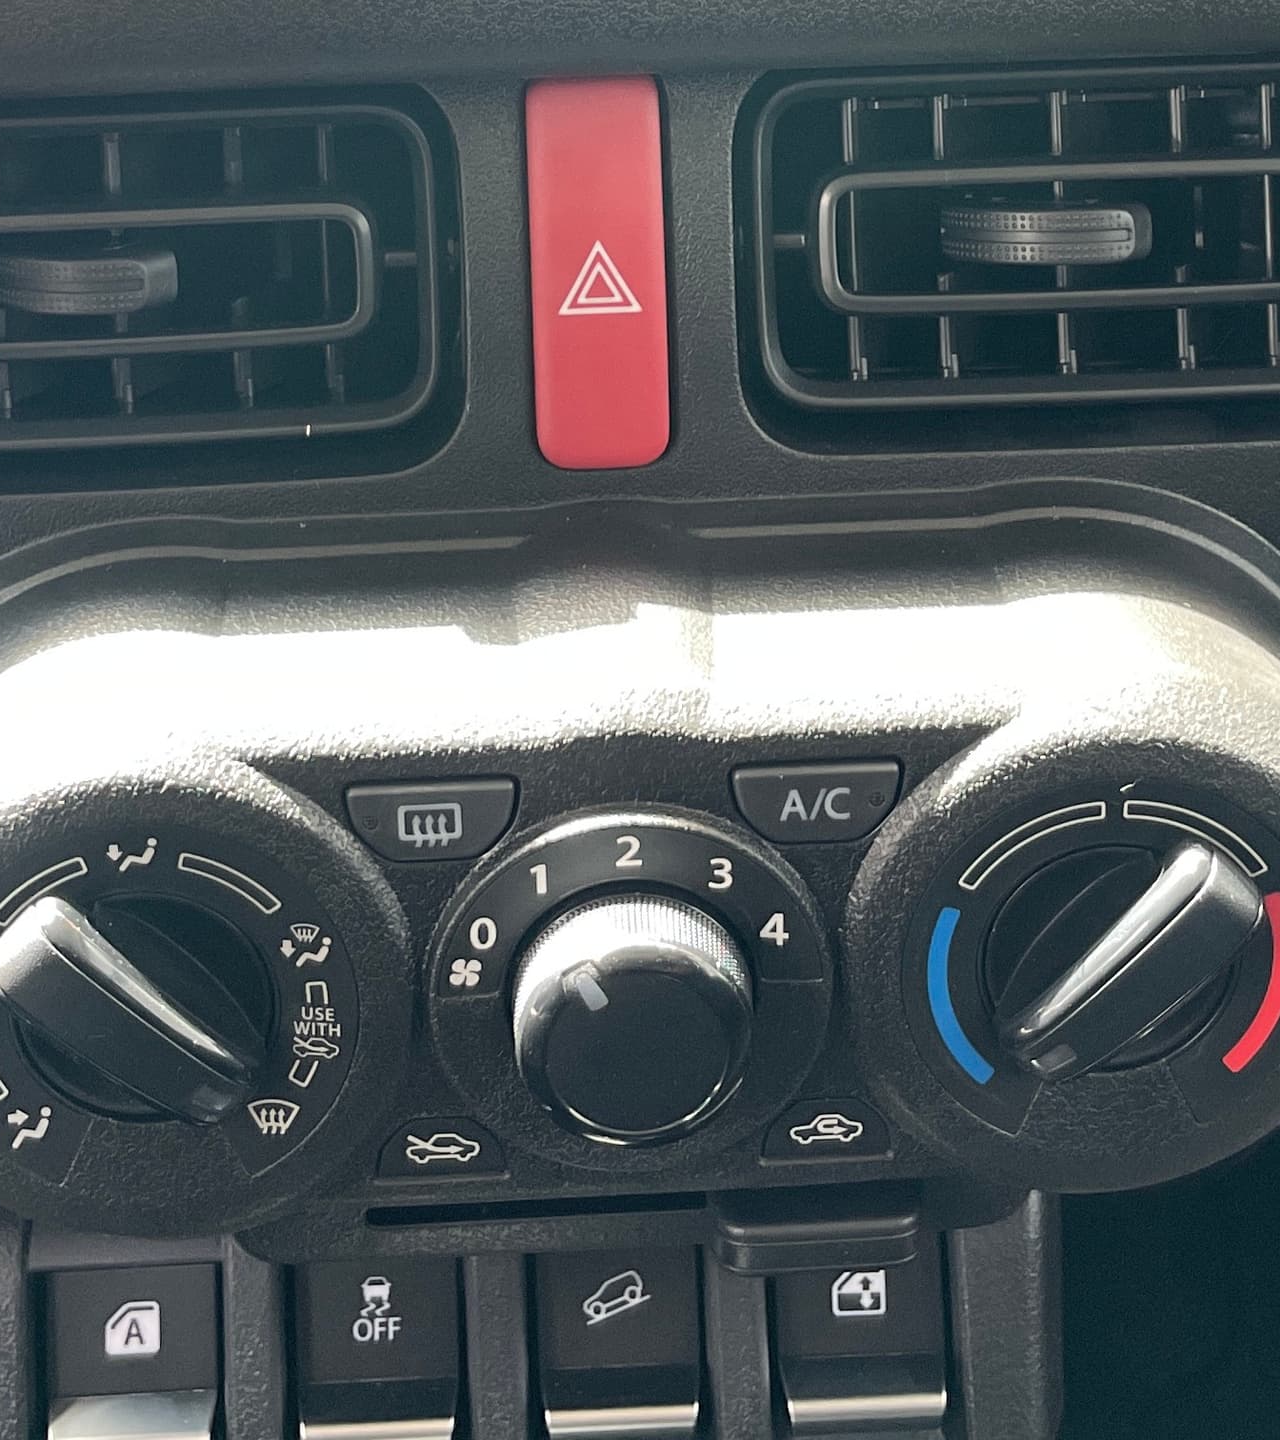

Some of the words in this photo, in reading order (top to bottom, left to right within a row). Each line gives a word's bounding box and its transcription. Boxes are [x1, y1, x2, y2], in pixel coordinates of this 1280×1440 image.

[779, 787, 851, 823] A/C
[615, 835, 643, 867] 2
[529, 863, 549, 895] 1
[708, 858, 734, 890] 3
[469, 917, 498, 951] 0
[758, 912, 790, 946] 4
[292, 1021, 342, 1038] WITH
[300, 1006, 336, 1023] USE
[123, 1317, 145, 1345] A
[352, 1317, 402, 1342] OFF
